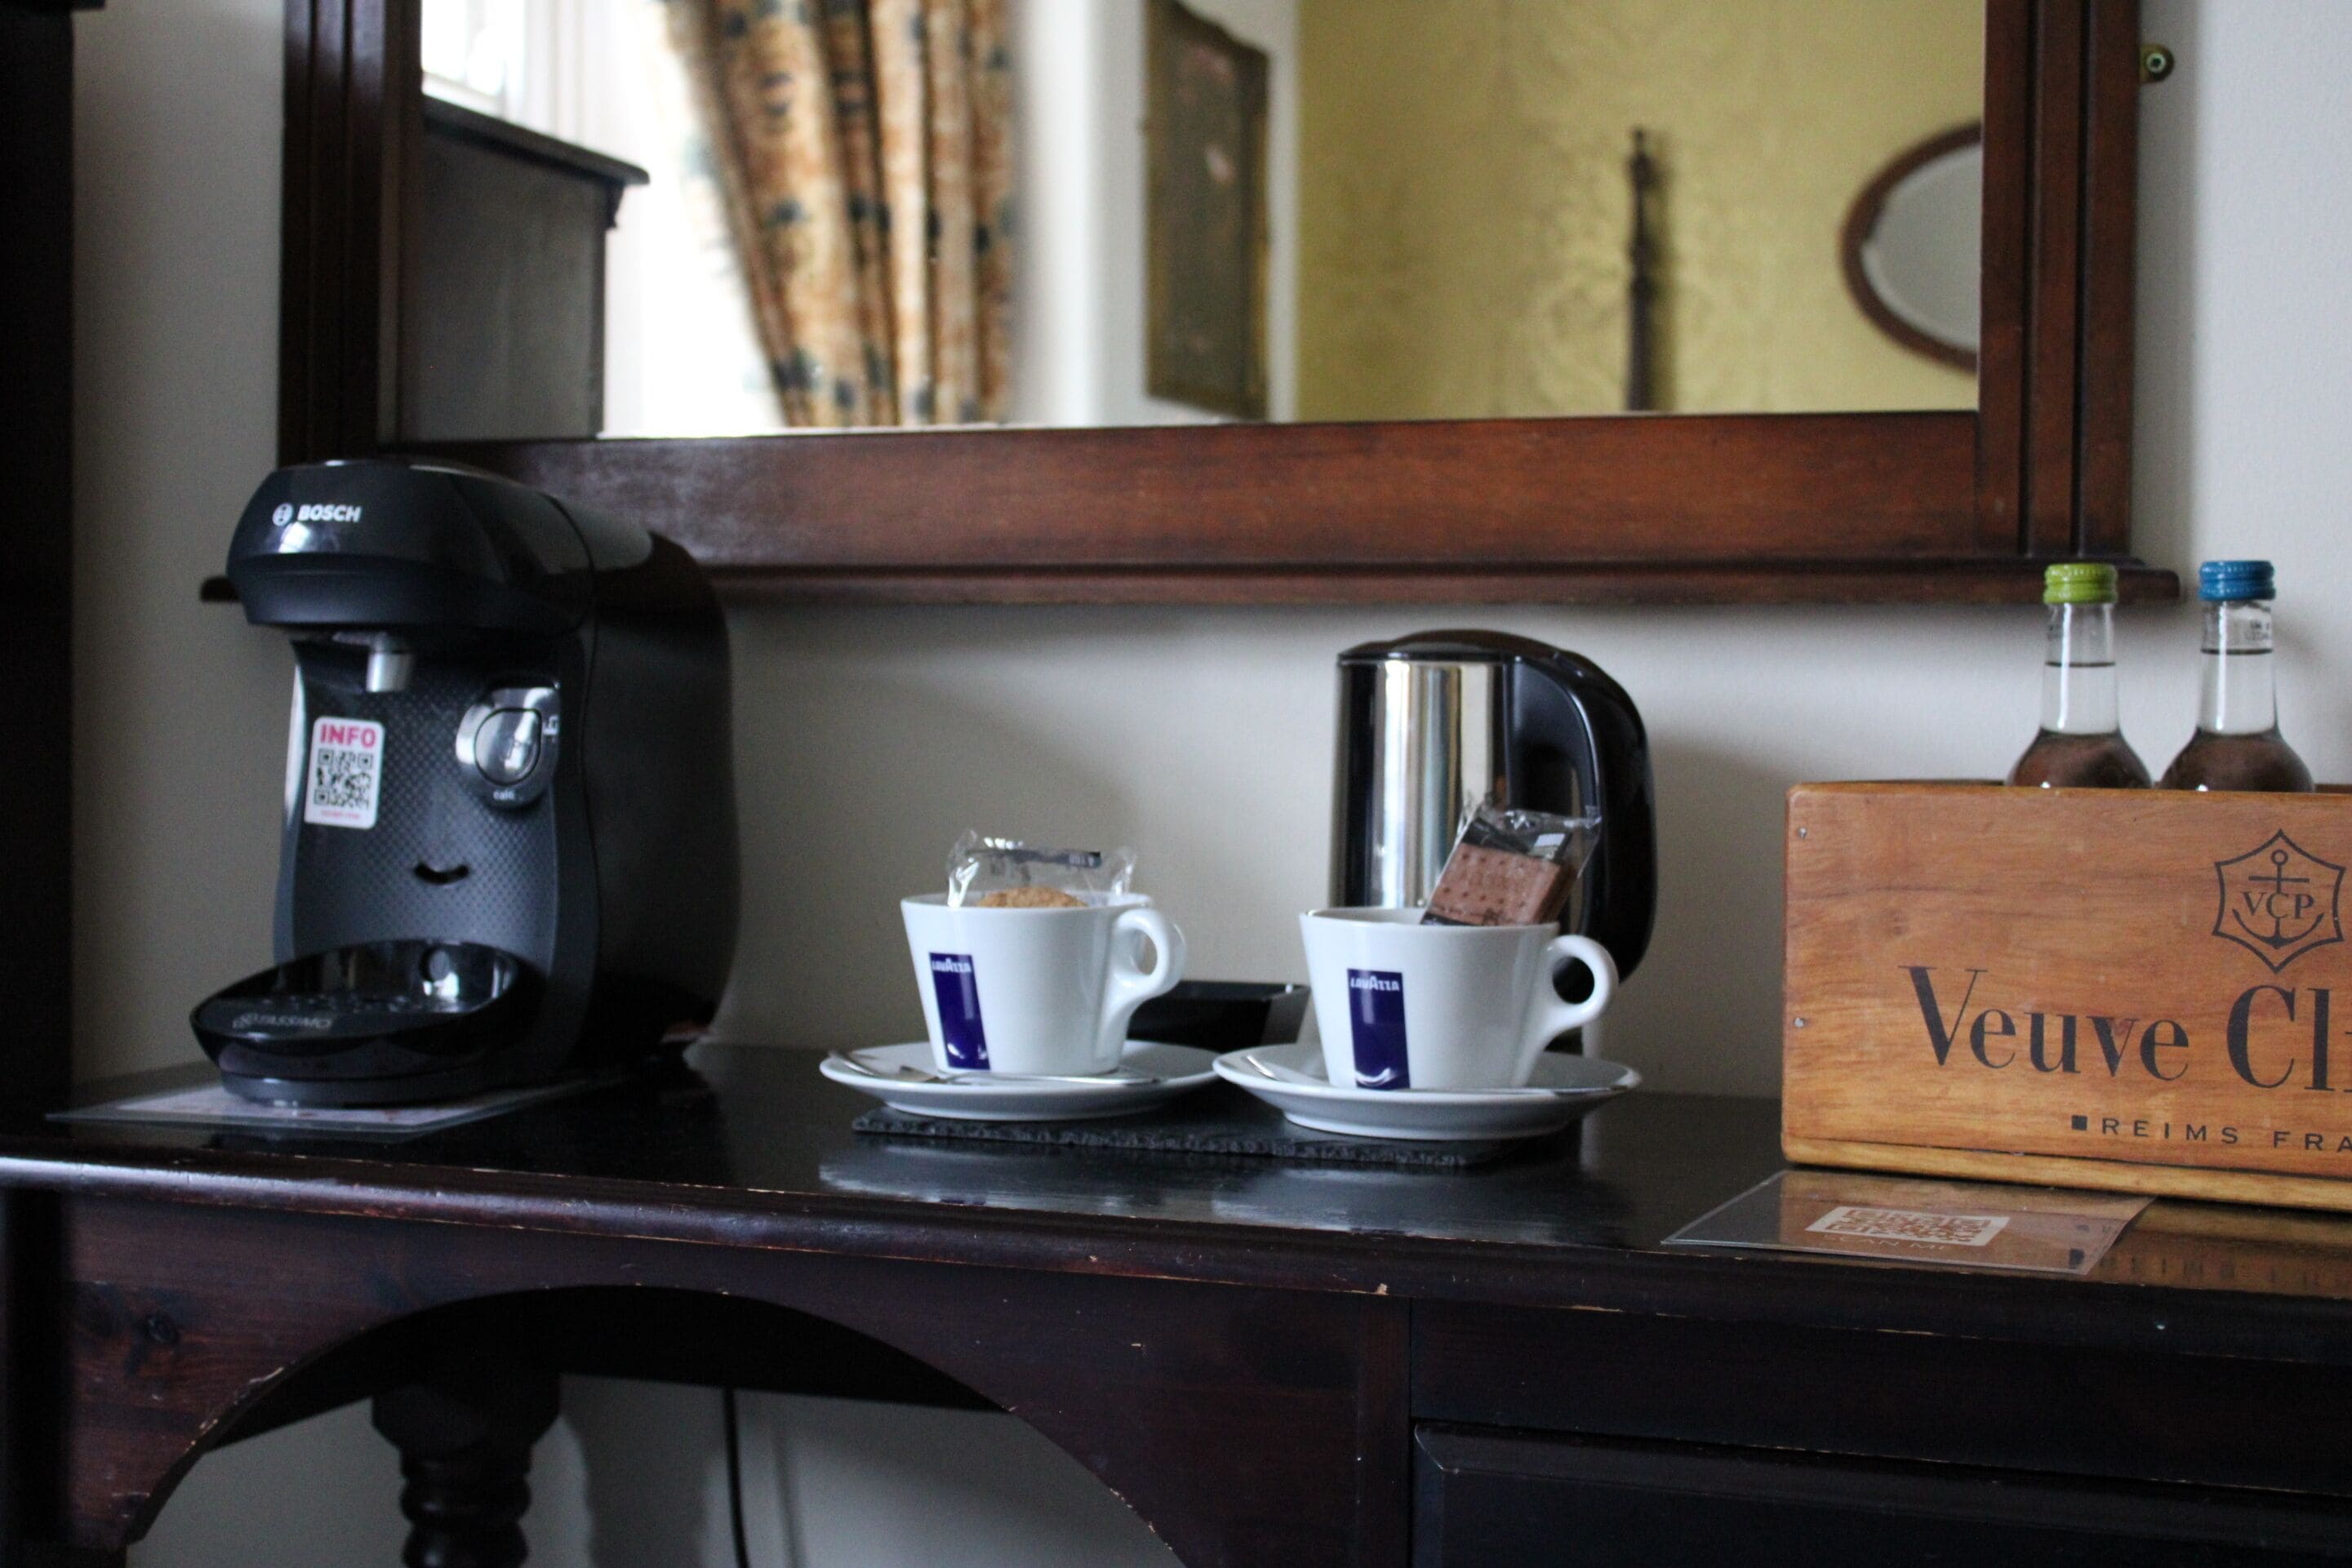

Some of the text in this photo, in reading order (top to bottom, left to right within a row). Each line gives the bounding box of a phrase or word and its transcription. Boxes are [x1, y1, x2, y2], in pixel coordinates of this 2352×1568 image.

[297, 504, 362, 522] BOSCH
[321, 724, 376, 748] INFO
[2240, 891, 2315, 920] VCP
[931, 957, 972, 973] LAVAZZA
[1350, 975, 1400, 992] LAVAZZA
[1898, 965, 2190, 1082] Veuve
[2101, 1117, 2352, 1153] REIMS FRA
